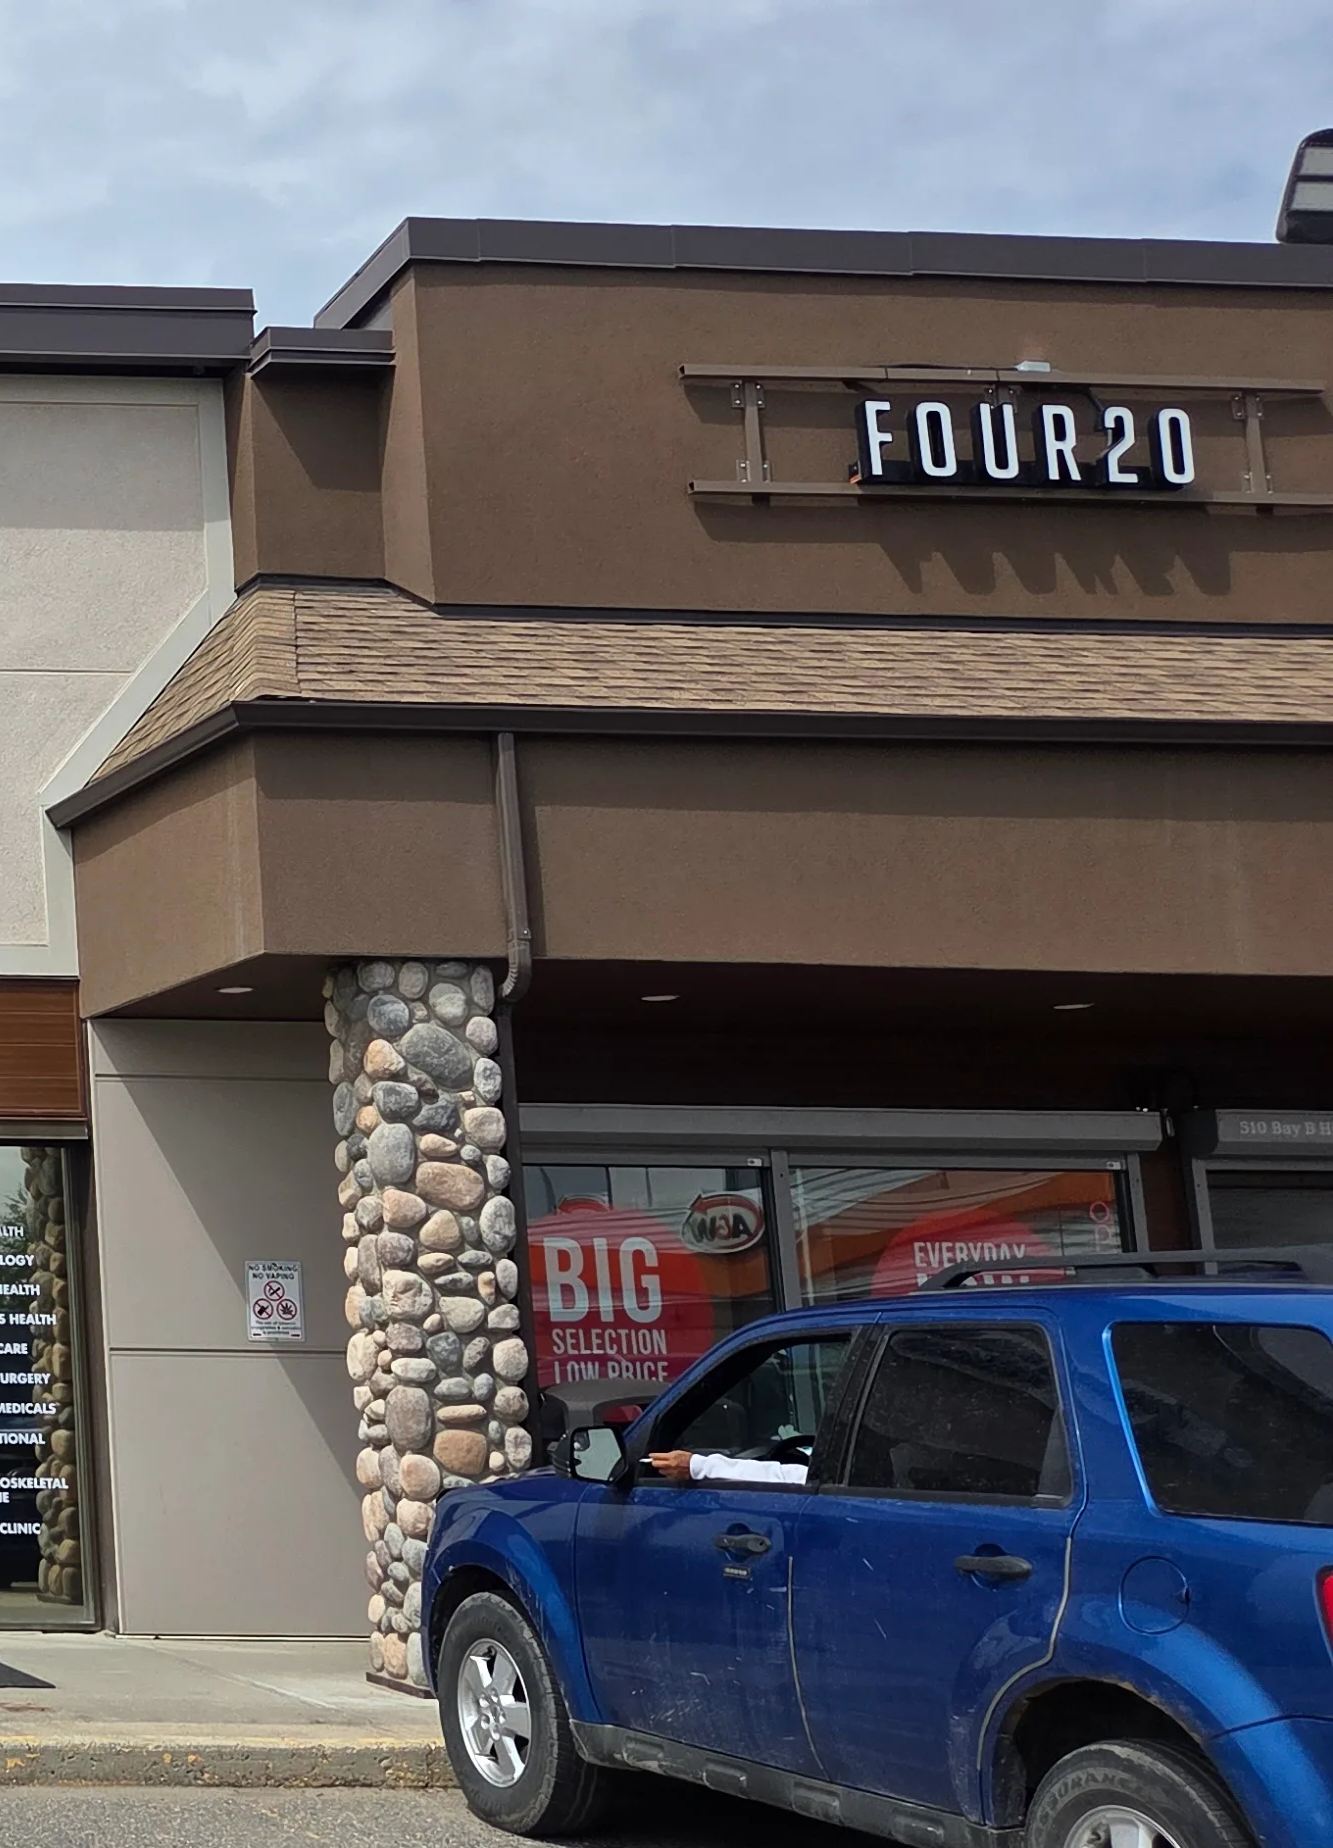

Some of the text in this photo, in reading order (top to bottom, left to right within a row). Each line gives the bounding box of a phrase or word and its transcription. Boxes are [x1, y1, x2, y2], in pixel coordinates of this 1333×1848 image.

[865, 400, 1195, 484] FOUR20
[1272, 1121, 1301, 1138] Bay
[913, 1242, 1026, 1268] EVERYDAY
[252, 1272, 264, 1280] NO
[543, 1237, 662, 1323] BIG
[10, 1314, 57, 1325] HEALTH
[552, 1328, 667, 1355] SELECTION
[554, 1361, 669, 1385] LOW PRICE
[0, 1523, 41, 1535] CLINIC
